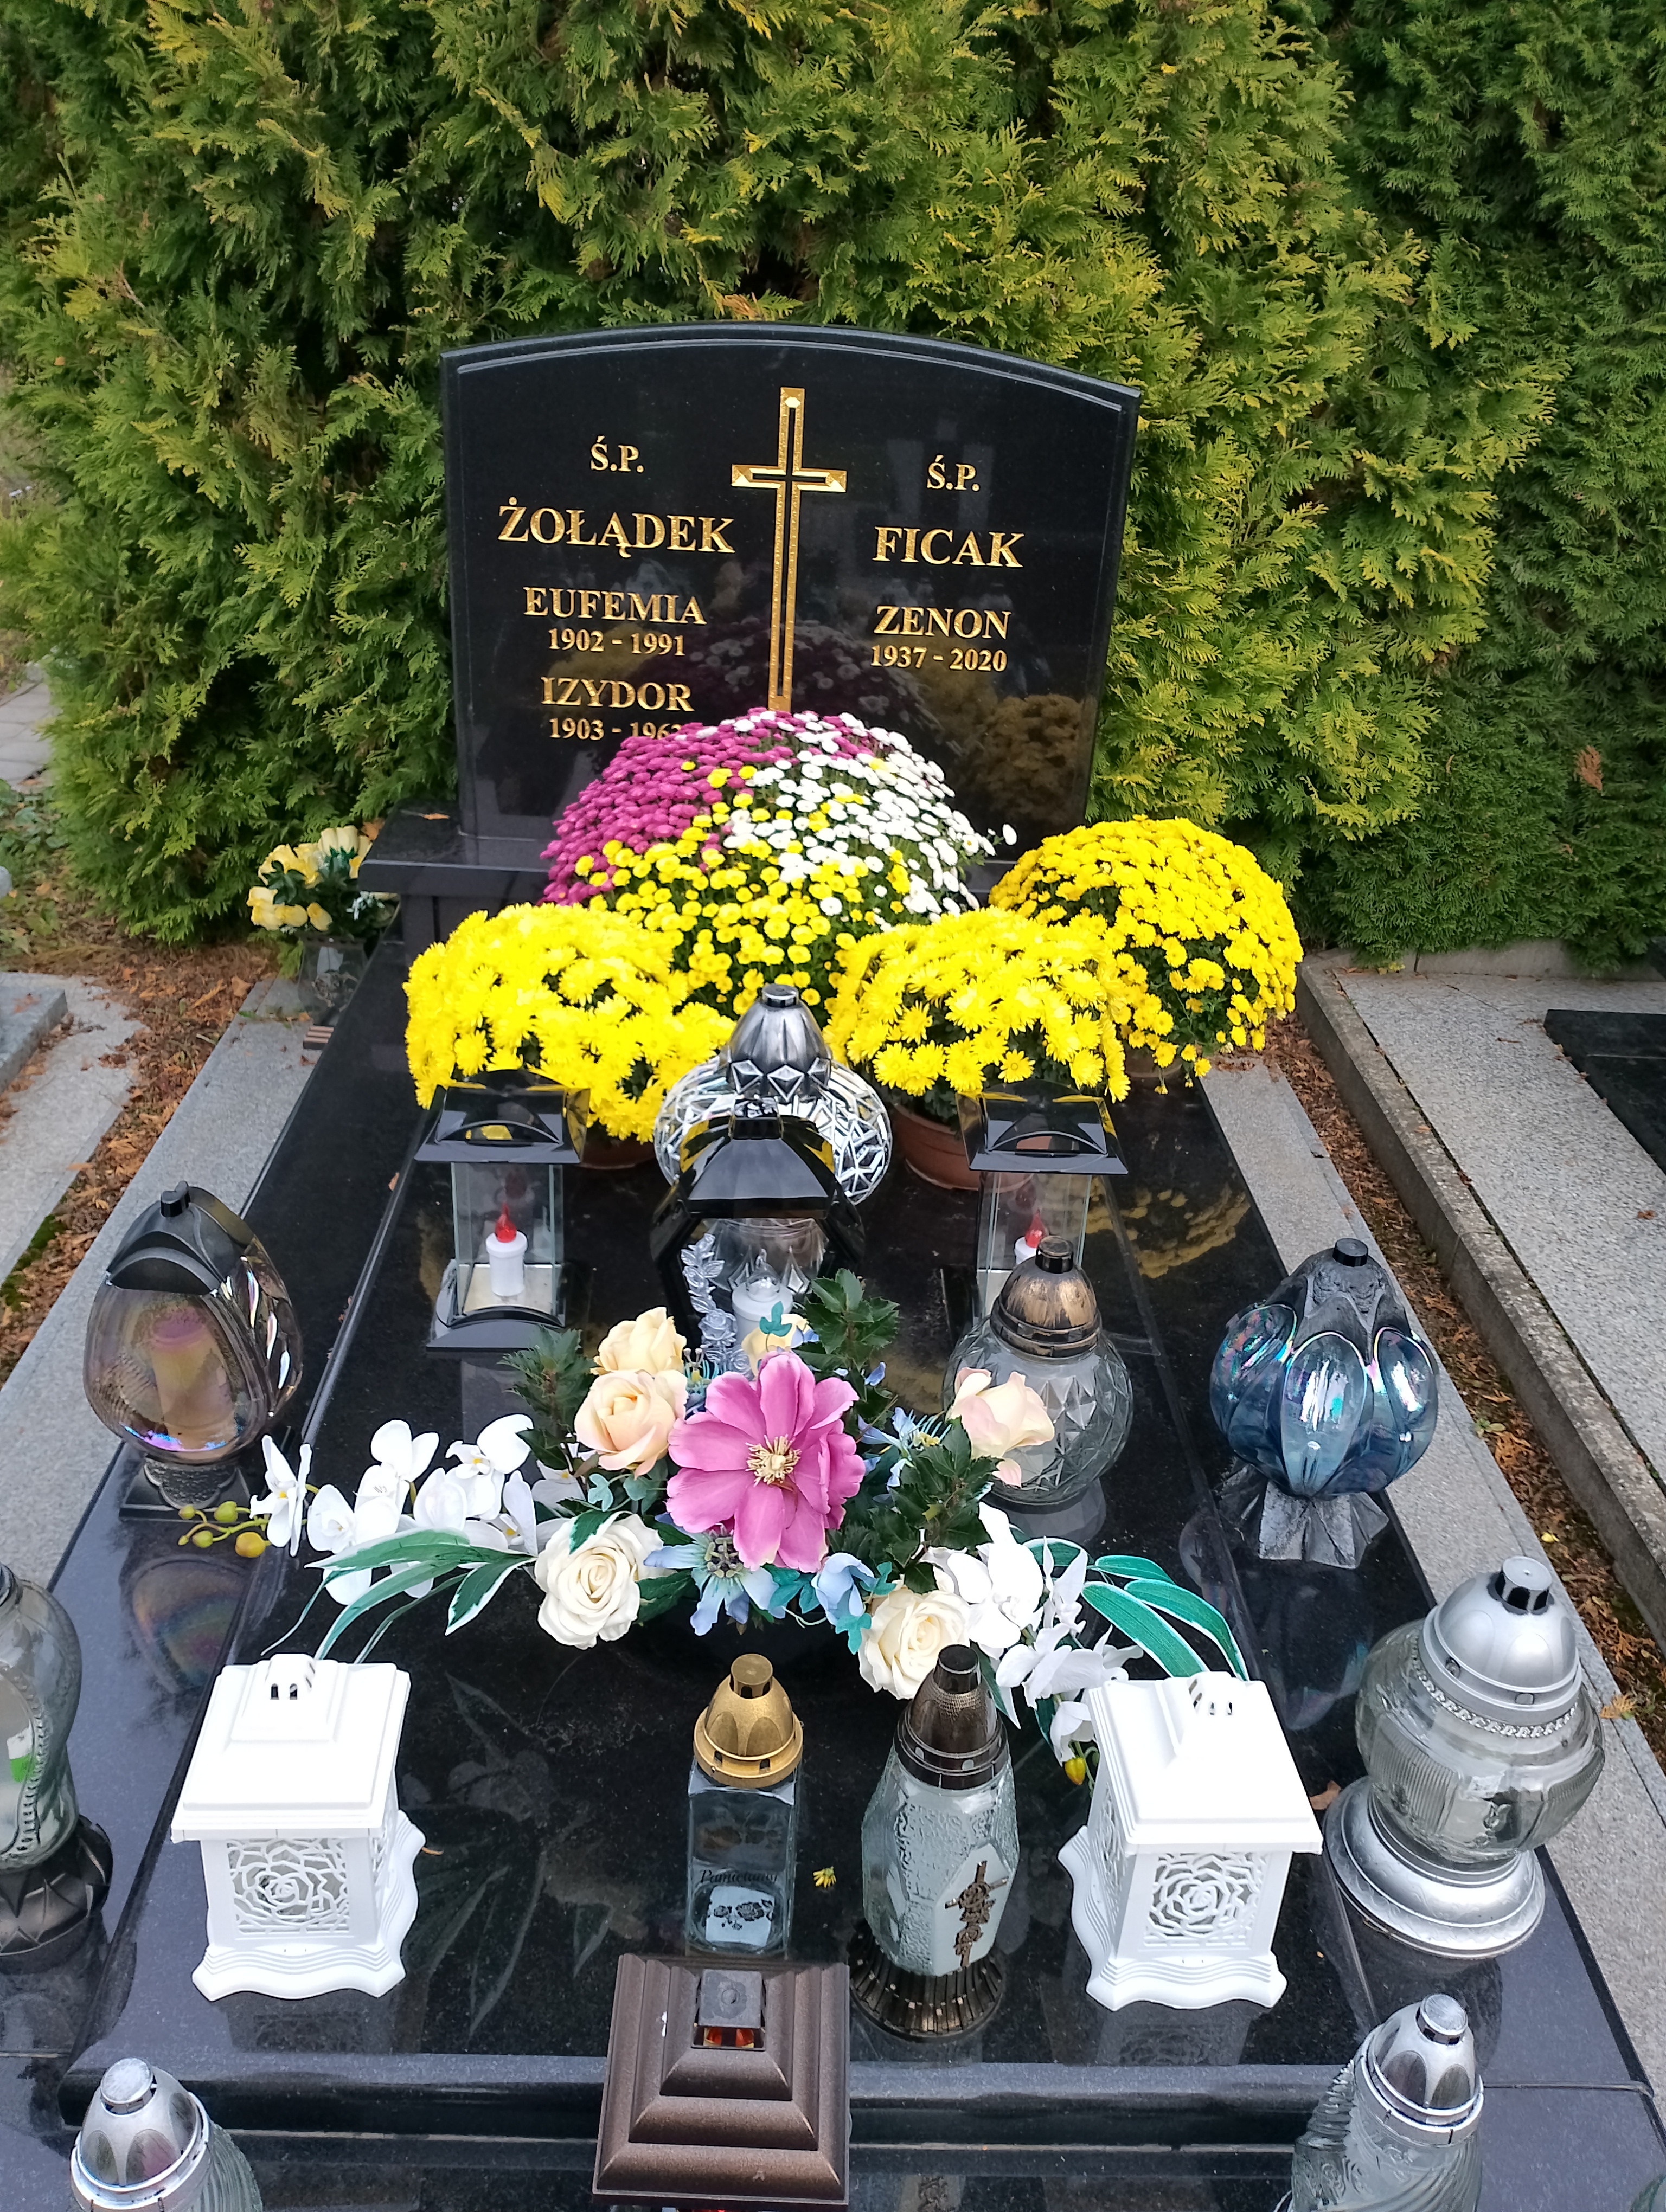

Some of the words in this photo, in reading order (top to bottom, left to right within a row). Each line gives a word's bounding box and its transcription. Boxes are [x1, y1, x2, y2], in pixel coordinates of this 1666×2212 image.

[591, 436, 644, 473] Ś.P.
[927, 455, 979, 491] Ś.P.
[498, 497, 735, 558] ŻOŁĄDEK
[872, 526, 1024, 568] FICAK
[523, 587, 707, 625] EUFEMIA
[874, 606, 1011, 640] ZENON
[548, 628, 605, 652] 1902
[630, 633, 685, 655] 1991
[871, 646, 926, 668] 1937
[949, 648, 1007, 672] 2020
[540, 677, 695, 711] IZYDOR
[549, 718, 604, 740] 1903
